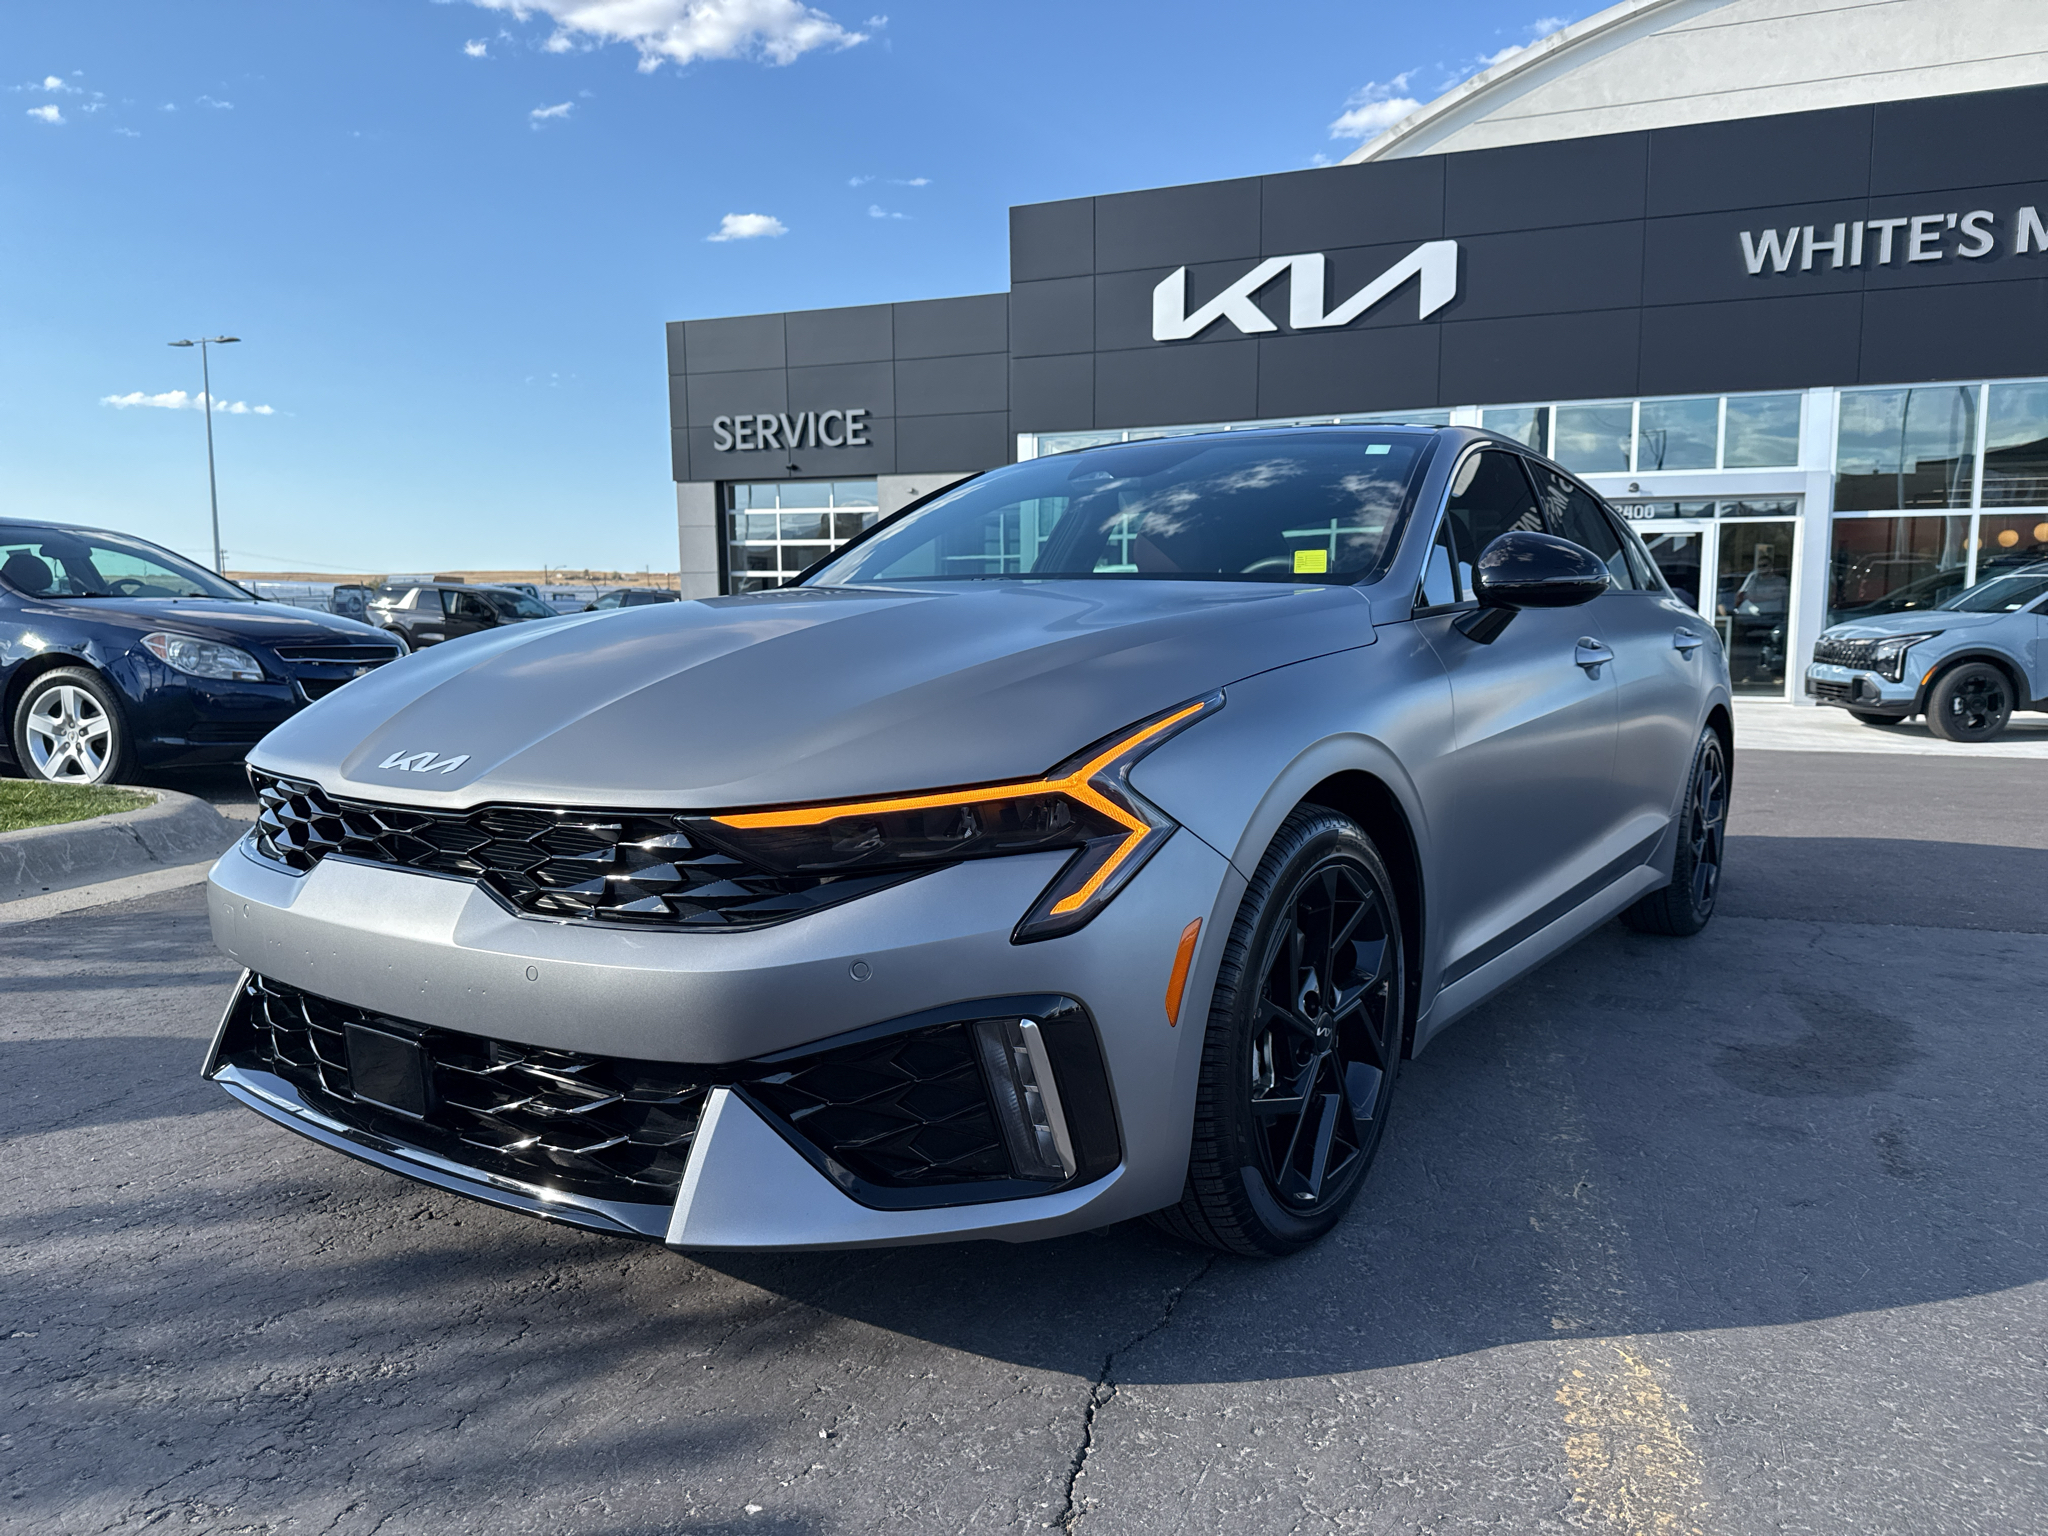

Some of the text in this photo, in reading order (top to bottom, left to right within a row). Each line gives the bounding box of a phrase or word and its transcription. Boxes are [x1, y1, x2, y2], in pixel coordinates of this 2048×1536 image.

[1740, 210, 1994, 275] WHITE'S
[1153, 240, 1457, 341] KIA
[713, 409, 867, 451] SERVICE
[378, 749, 471, 774] KIA
